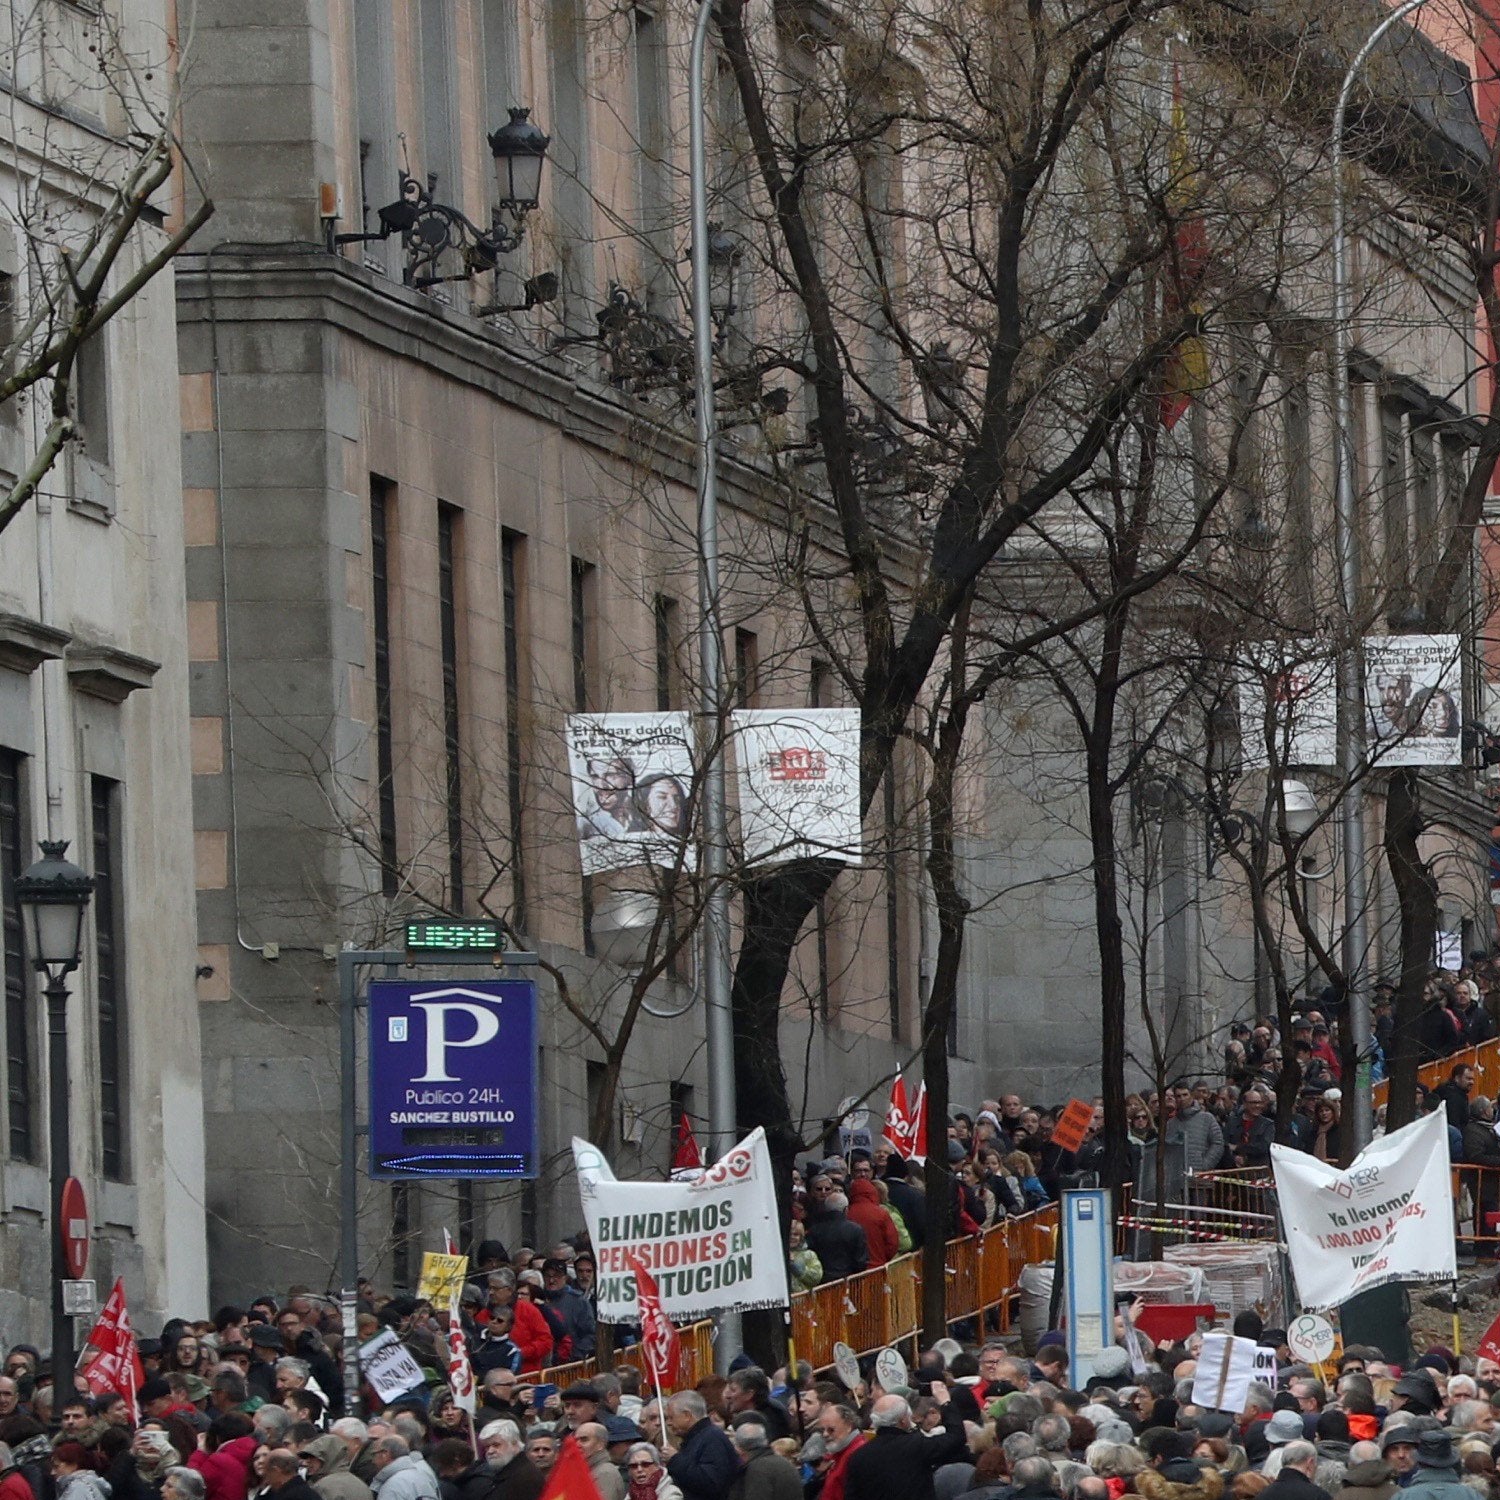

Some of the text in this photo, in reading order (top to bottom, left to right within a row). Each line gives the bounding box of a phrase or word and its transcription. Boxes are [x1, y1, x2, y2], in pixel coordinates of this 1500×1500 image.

[409, 1001, 500, 1082] P
[468, 1088, 504, 1103] 24H.
[389, 1110, 515, 1124] SANCHEZ BUSTILLO
[1348, 1165, 1380, 1188] MERP
[598, 1199, 733, 1243] BLINDEMOS
[1328, 1210, 1348, 1229] Ya
[1317, 1225, 1383, 1250] 1.000.000
[599, 1227, 753, 1273] PENSIONES EN
